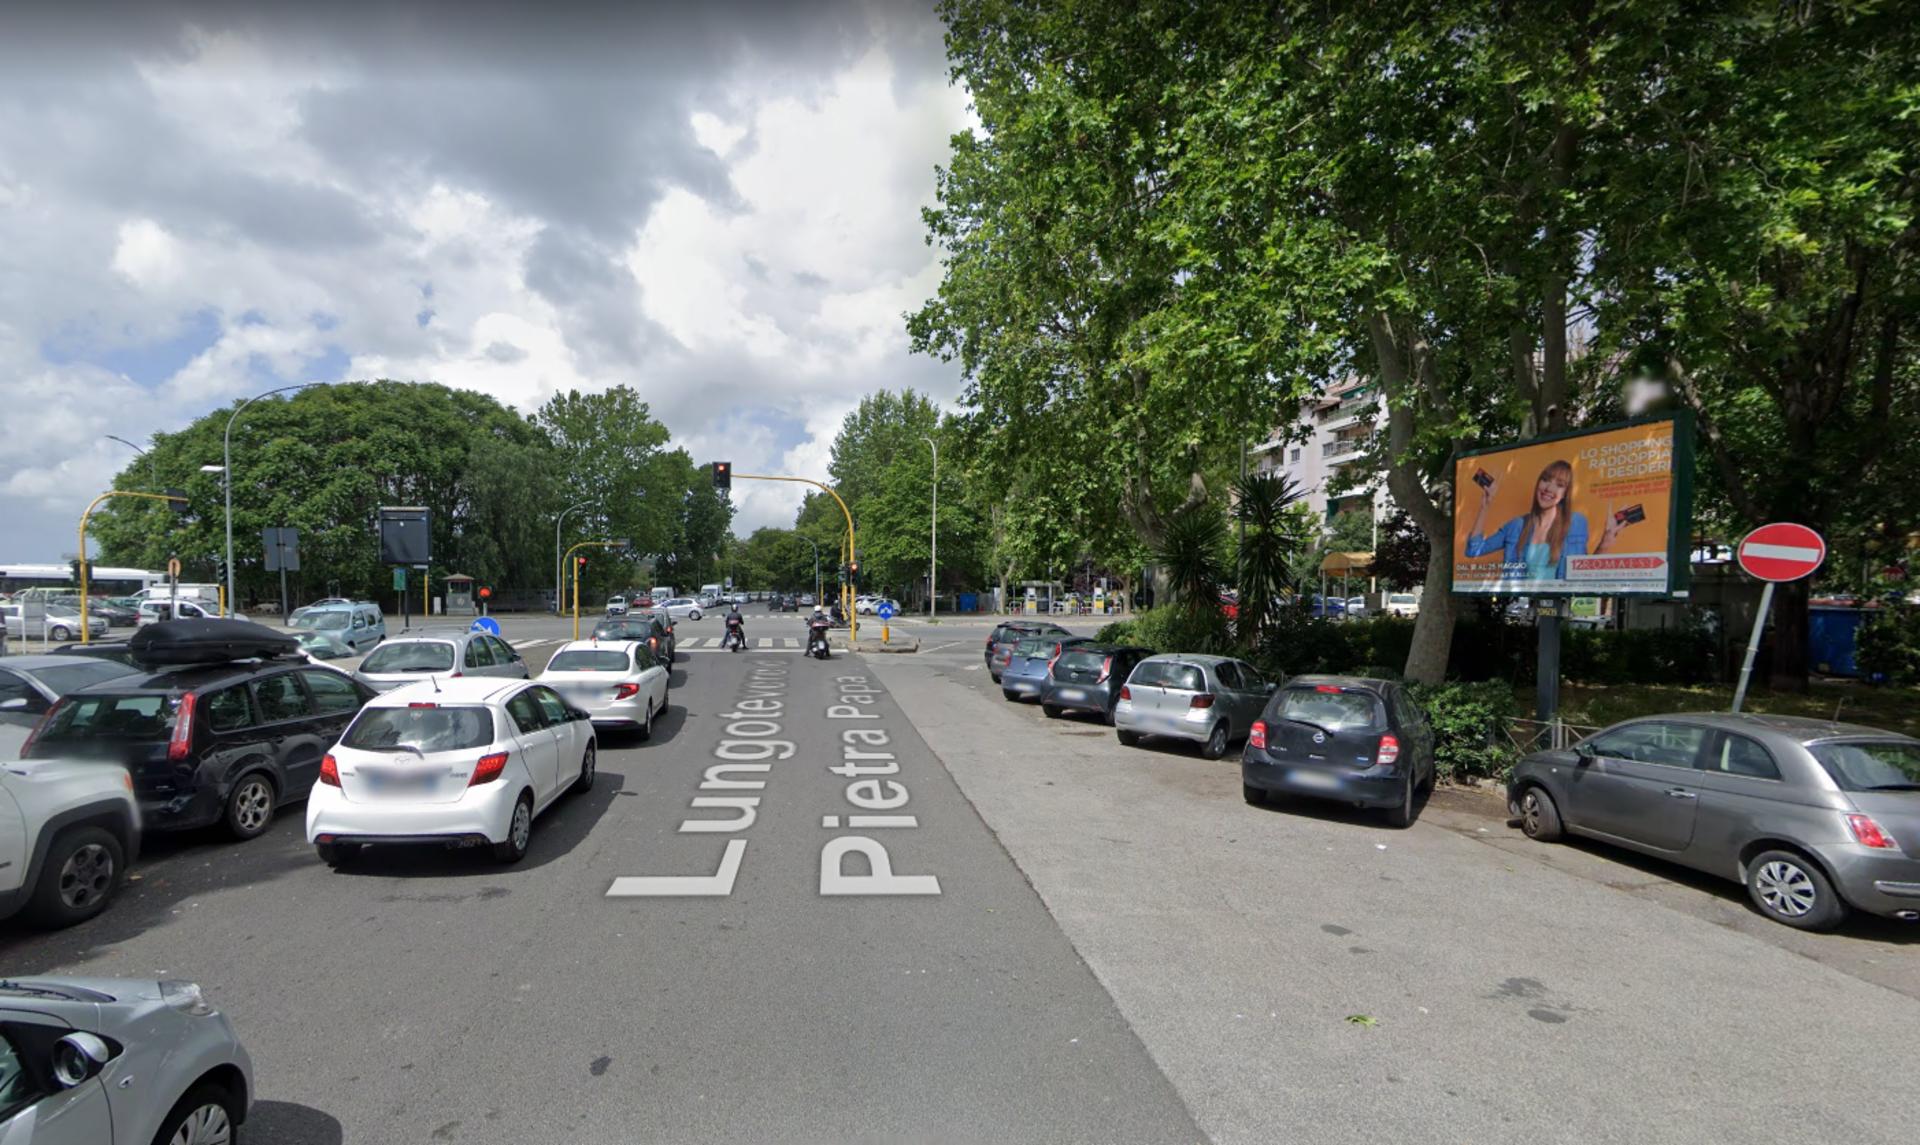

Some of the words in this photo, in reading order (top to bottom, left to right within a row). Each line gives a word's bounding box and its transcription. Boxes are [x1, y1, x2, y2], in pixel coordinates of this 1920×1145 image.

[1580, 448, 1598, 459] LO
[1601, 436, 1672, 456] SHOPPING
[1588, 450, 1671, 470] RADDOPPIA
[1607, 459, 1671, 478] DESIDERI
[1498, 562, 1527, 570] MAGGIO
